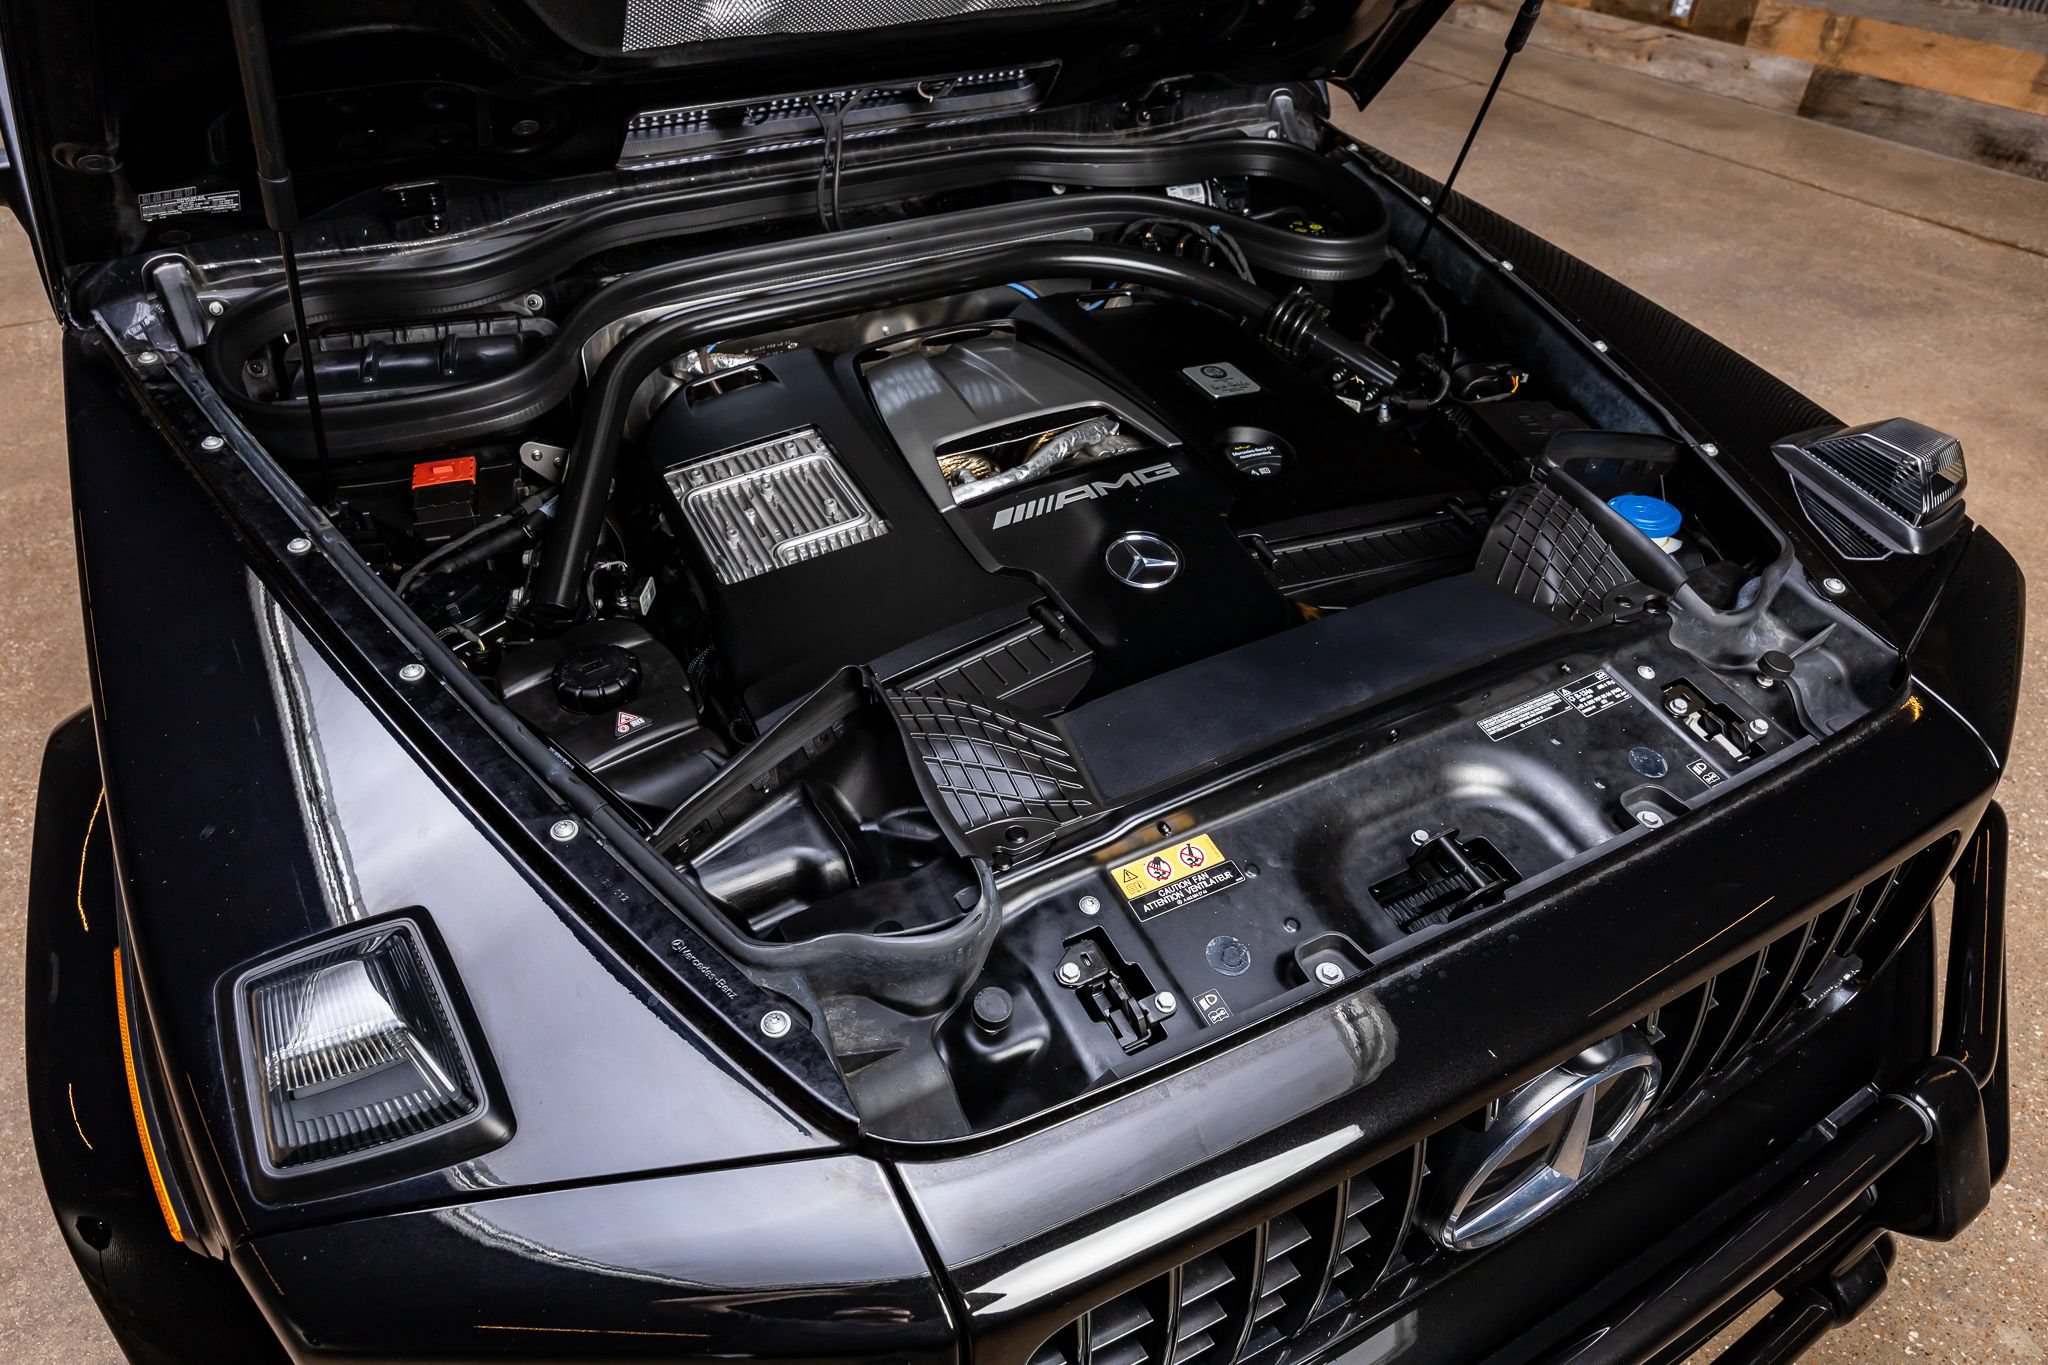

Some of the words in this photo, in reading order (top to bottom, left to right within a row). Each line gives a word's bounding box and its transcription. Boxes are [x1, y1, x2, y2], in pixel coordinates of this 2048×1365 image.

[1055, 462, 1180, 511] AMG
[1143, 891, 1185, 913] ATTENTION
[1185, 871, 1234, 894] VENTILATEUR
[1158, 879, 1191, 897] CAUTION
[1192, 872, 1209, 884] FAN
[679, 946, 737, 999] Mercedes-Benz
